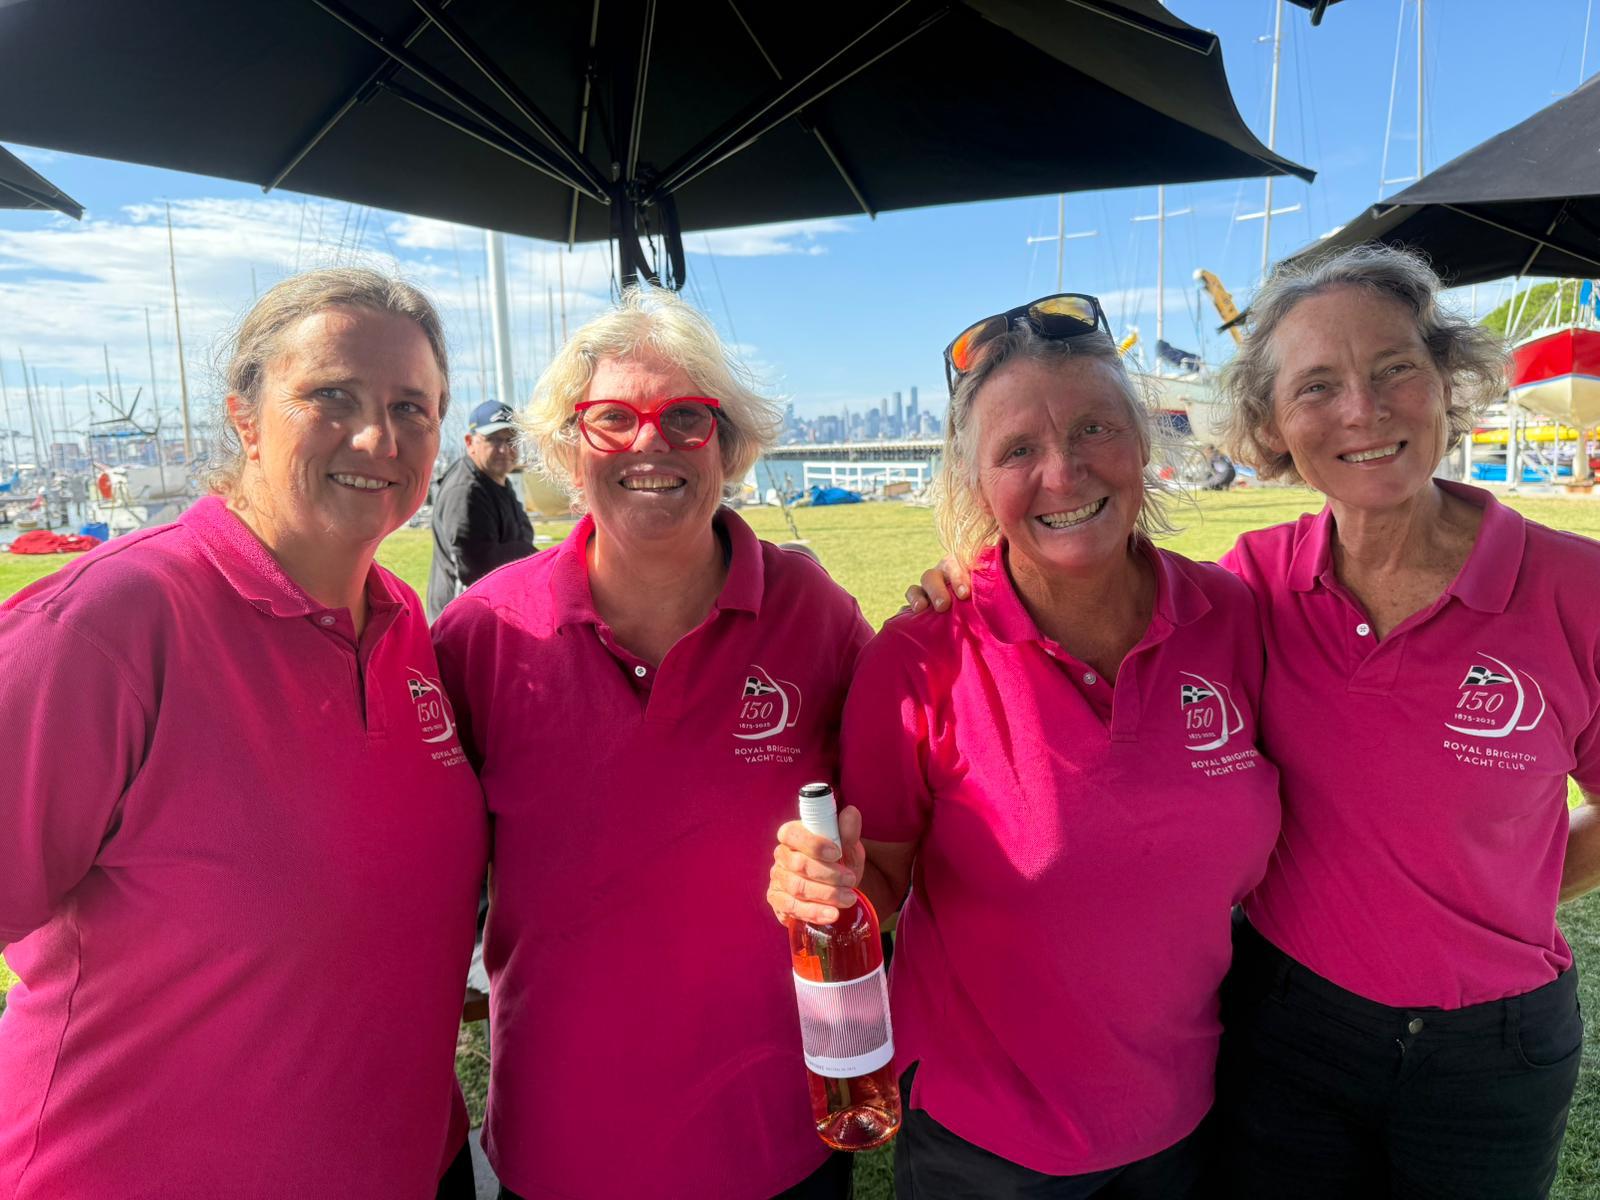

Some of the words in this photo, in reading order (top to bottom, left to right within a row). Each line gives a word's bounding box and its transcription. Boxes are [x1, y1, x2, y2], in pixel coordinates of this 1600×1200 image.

[740, 701, 773, 719] 150
[1456, 690, 1504, 713] 150
[417, 700, 440, 722] 150
[1186, 707, 1214, 729] 150
[1454, 713, 1496, 726] 1875-2025
[734, 747, 764, 755] ROYAL
[766, 745, 801, 755] BRIGHTON
[745, 754, 775, 763] YACHT
[1443, 740, 1482, 755] ROYAL
[1486, 748, 1537, 762] BRIGHTON
[1191, 759, 1221, 769] ROYAL
[1203, 765, 1235, 777] YACHT
[1235, 760, 1256, 770] CLUB
[1455, 753, 1493, 768] YACHT
[1498, 760, 1526, 771] CLUB
